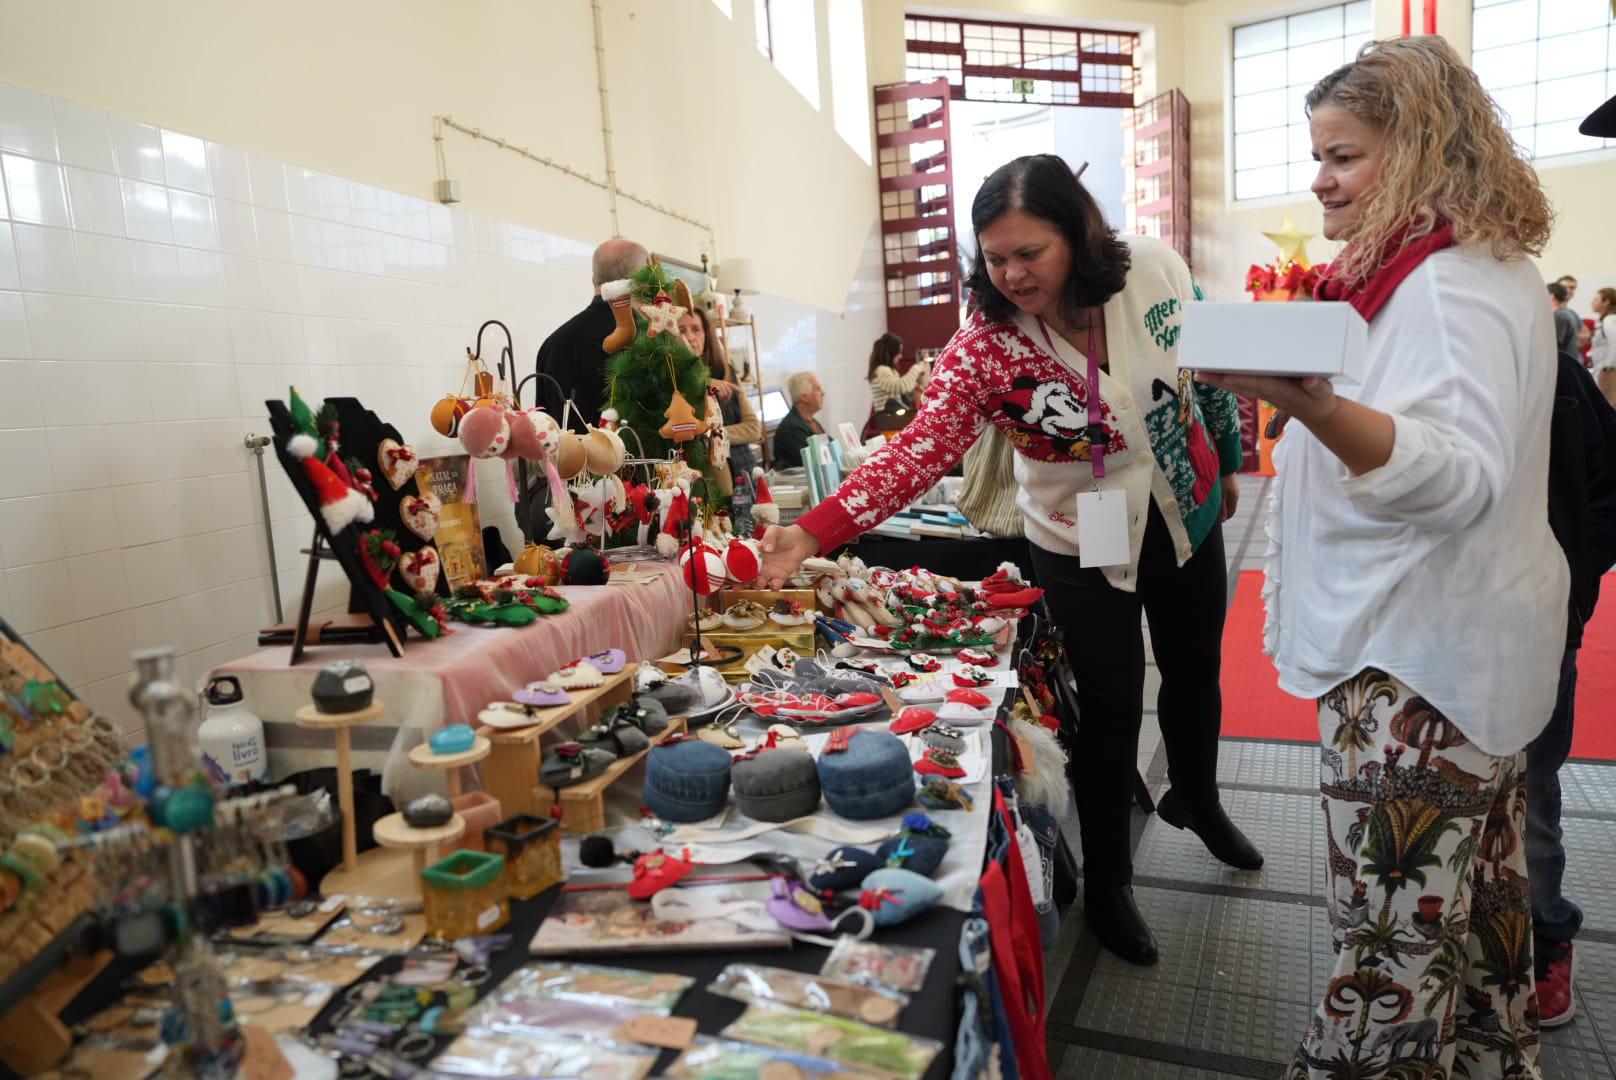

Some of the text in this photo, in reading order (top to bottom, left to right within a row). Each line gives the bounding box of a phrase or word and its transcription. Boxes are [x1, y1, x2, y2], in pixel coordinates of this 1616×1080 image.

[1144, 298, 1179, 336] Mer
[1155, 325, 1181, 352] Xm
[232, 746, 259, 761] livro
